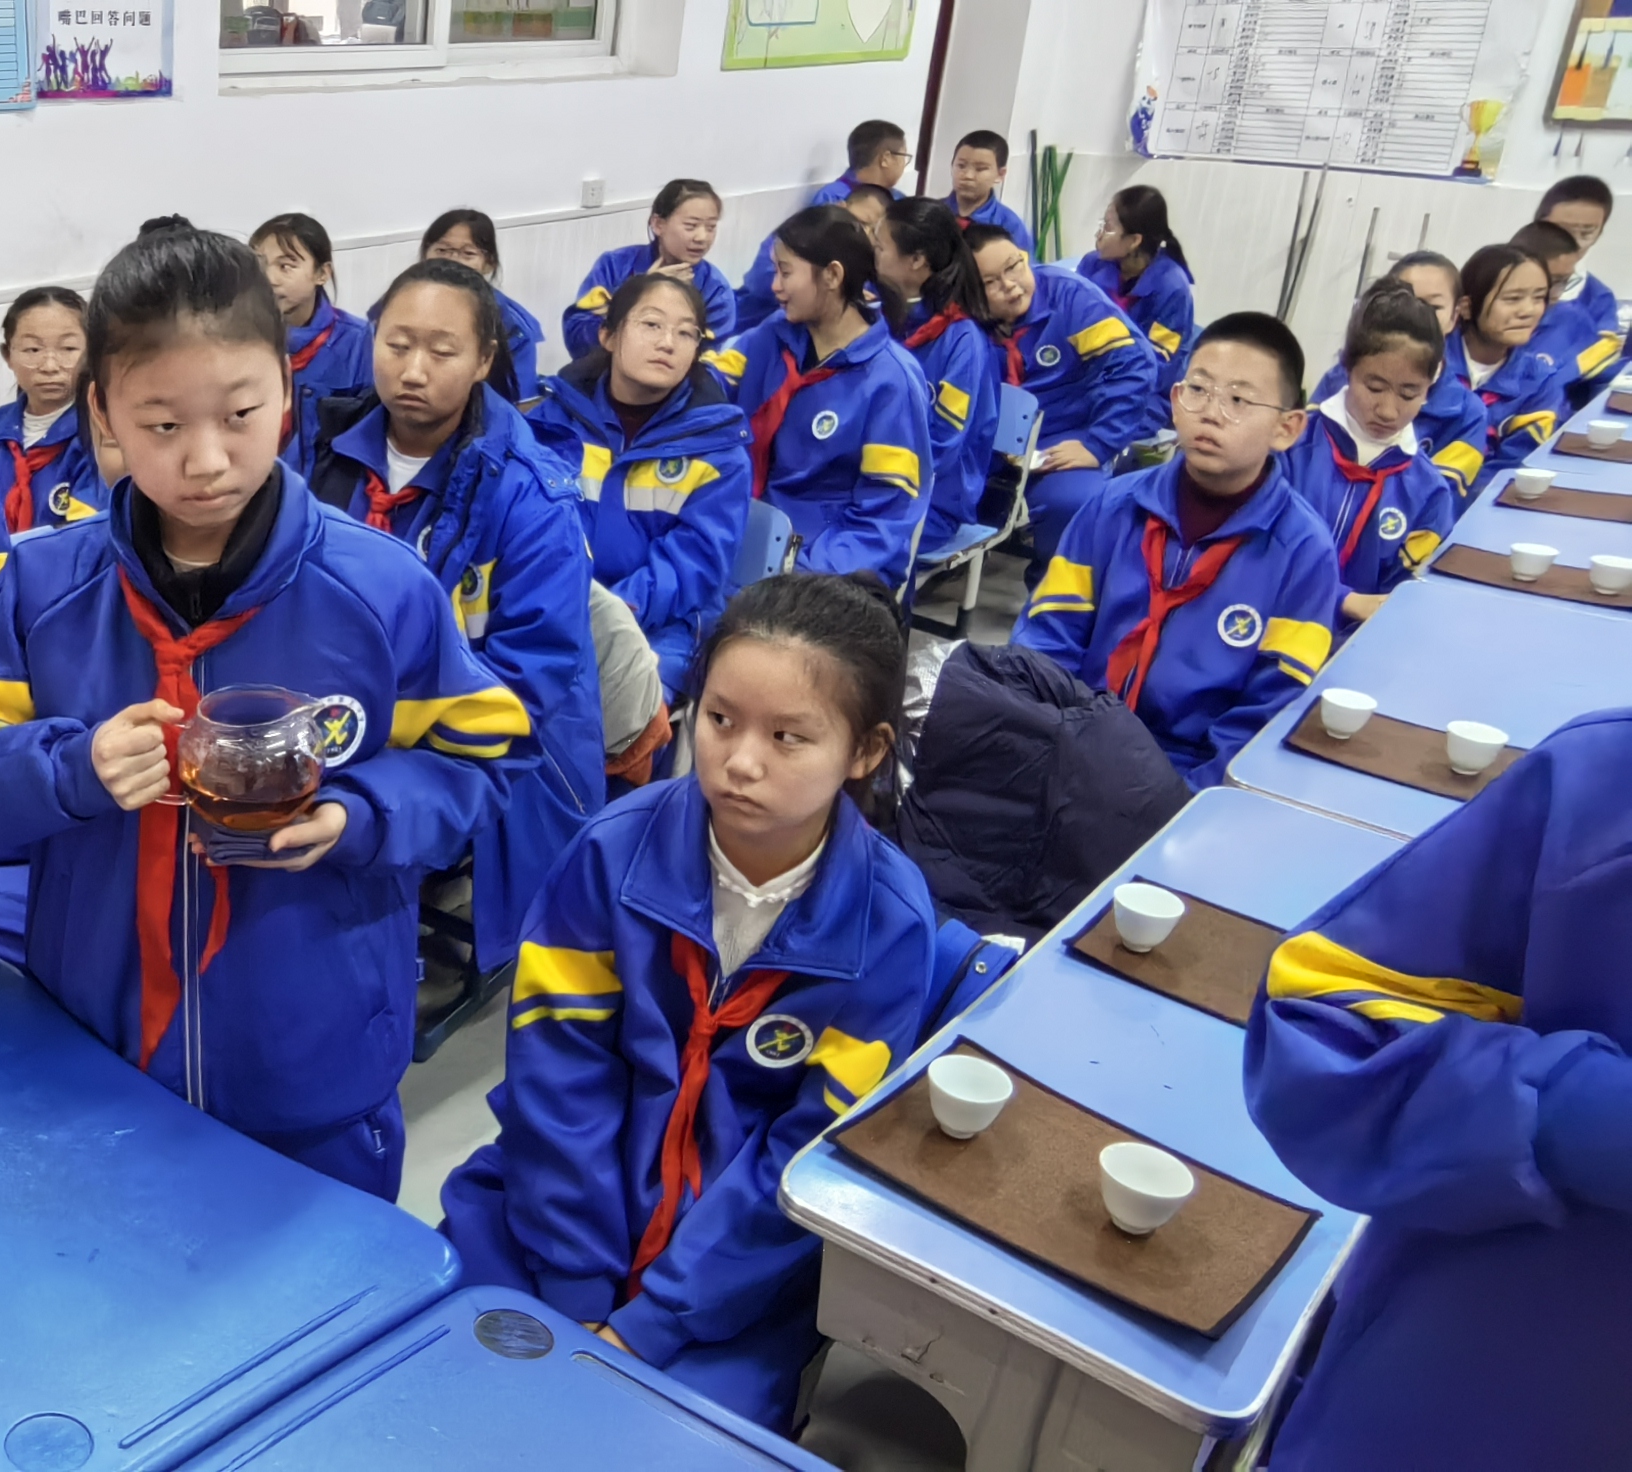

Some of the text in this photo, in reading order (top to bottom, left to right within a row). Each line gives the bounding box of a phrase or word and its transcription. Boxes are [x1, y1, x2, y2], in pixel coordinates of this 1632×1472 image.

[58, 9, 152, 27] 嘴巴回答问题
